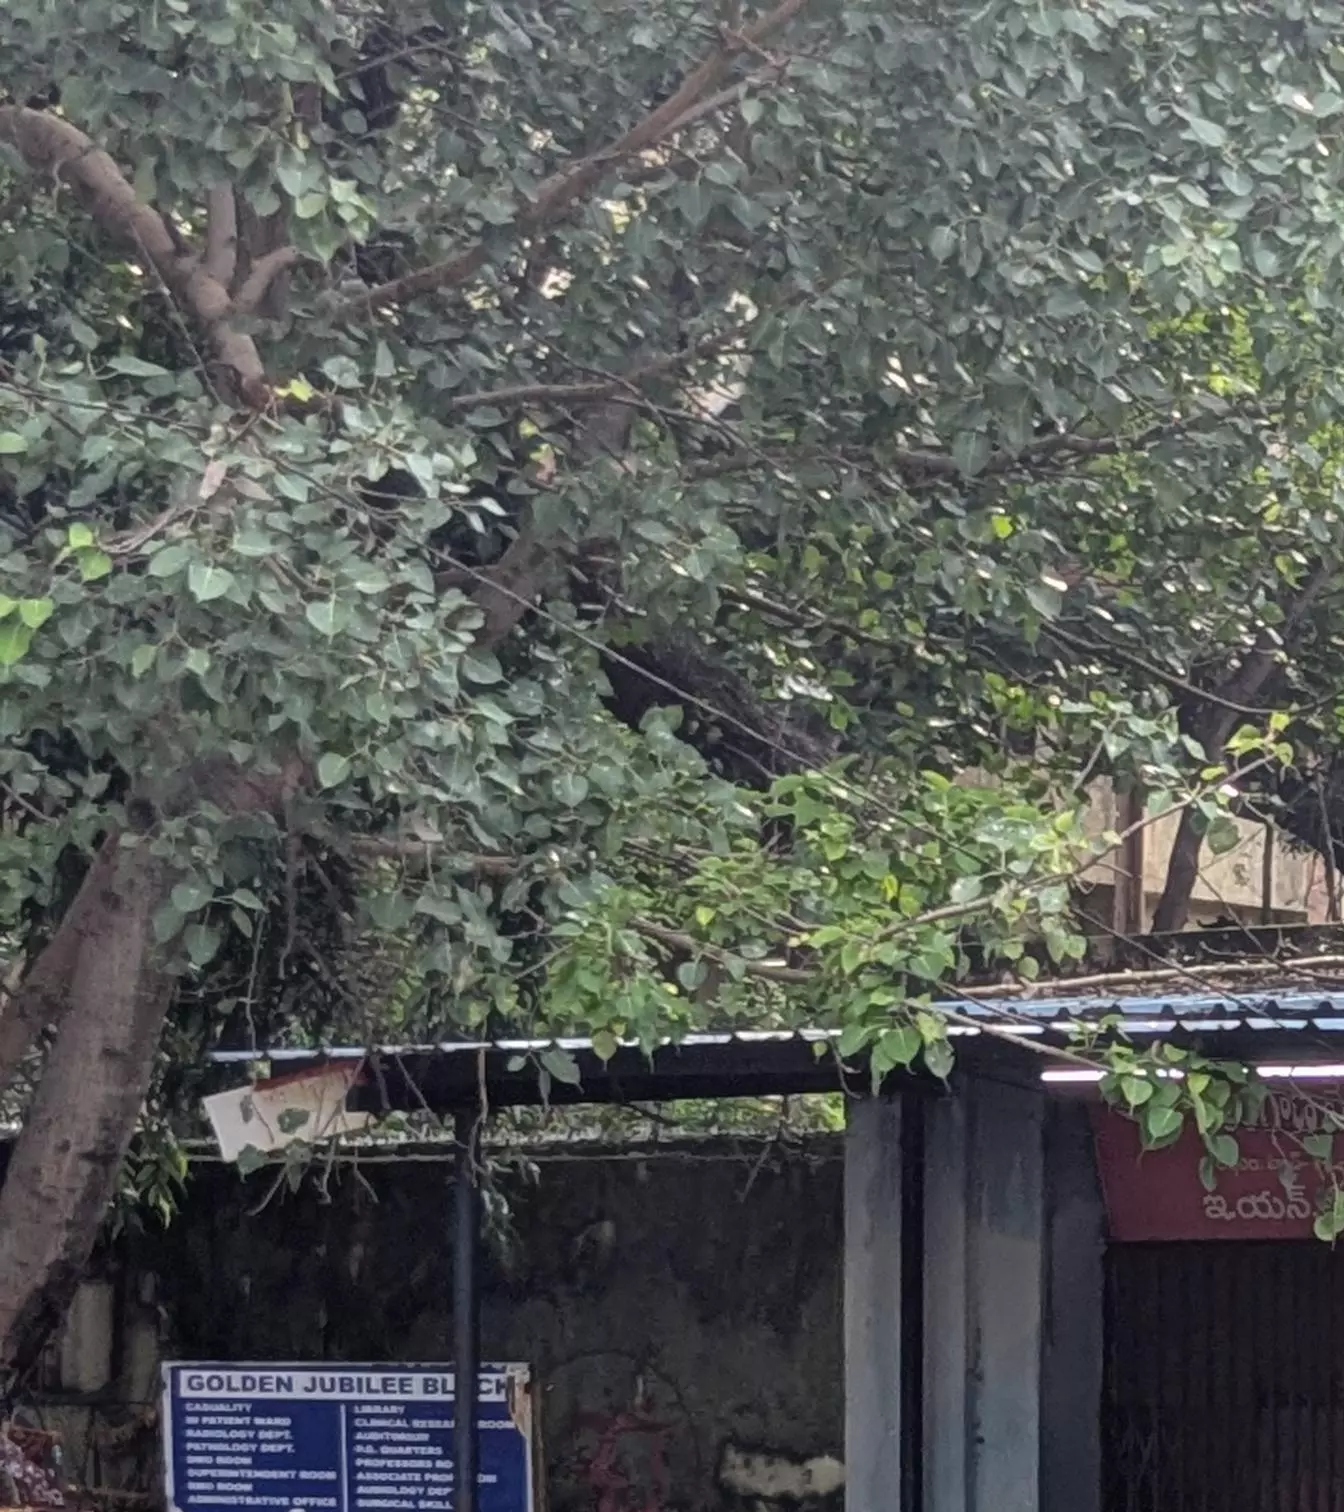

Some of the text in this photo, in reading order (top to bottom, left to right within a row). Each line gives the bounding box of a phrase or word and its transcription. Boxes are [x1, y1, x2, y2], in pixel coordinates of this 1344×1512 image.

[187, 1374, 294, 1393] GOLDEN
[303, 1376, 414, 1394] JUBILEE
[354, 1405, 406, 1414] LIBRARY
[201, 1416, 252, 1425] PATIENT
[253, 1417, 292, 1426] WARD
[354, 1418, 409, 1428] CLINICAL
[185, 1429, 292, 1440] RADIOLOGY DEPT.
[260, 1444, 295, 1453] DEPT.
[215, 1456, 252, 1465] ROOM
[187, 1469, 337, 1480] SUPERINTENDENT ROOM
[216, 1482, 253, 1492] ROOM
[292, 1497, 337, 1507] OFFICE
